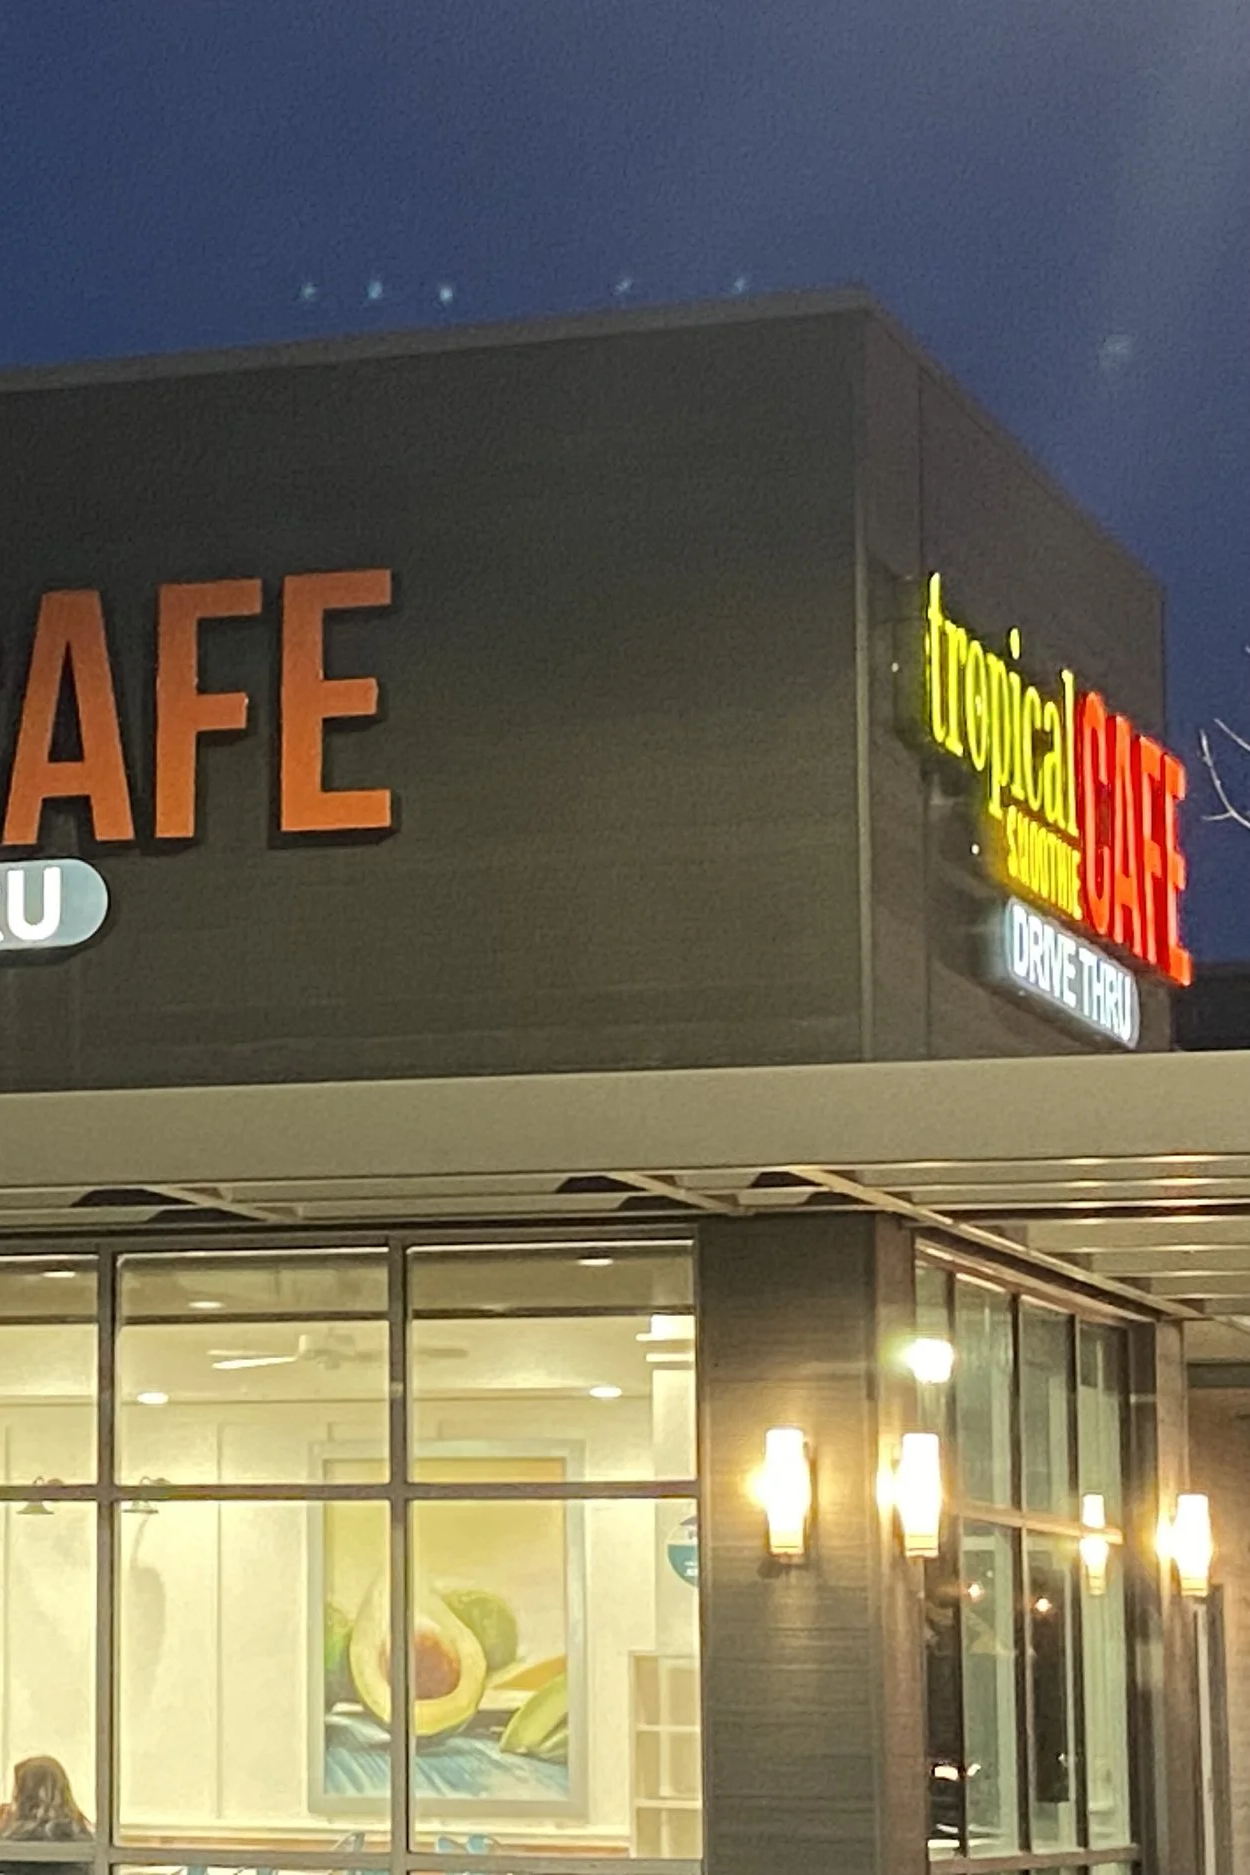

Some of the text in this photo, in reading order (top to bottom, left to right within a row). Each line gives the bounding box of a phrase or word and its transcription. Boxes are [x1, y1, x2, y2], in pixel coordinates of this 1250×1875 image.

[927, 571, 1079, 838] tropical
[1006, 804, 1083, 921] SMOOTHIE
[1080, 691, 1193, 987] CAFE
[1012, 903, 1133, 1043] DRIVE THRU
